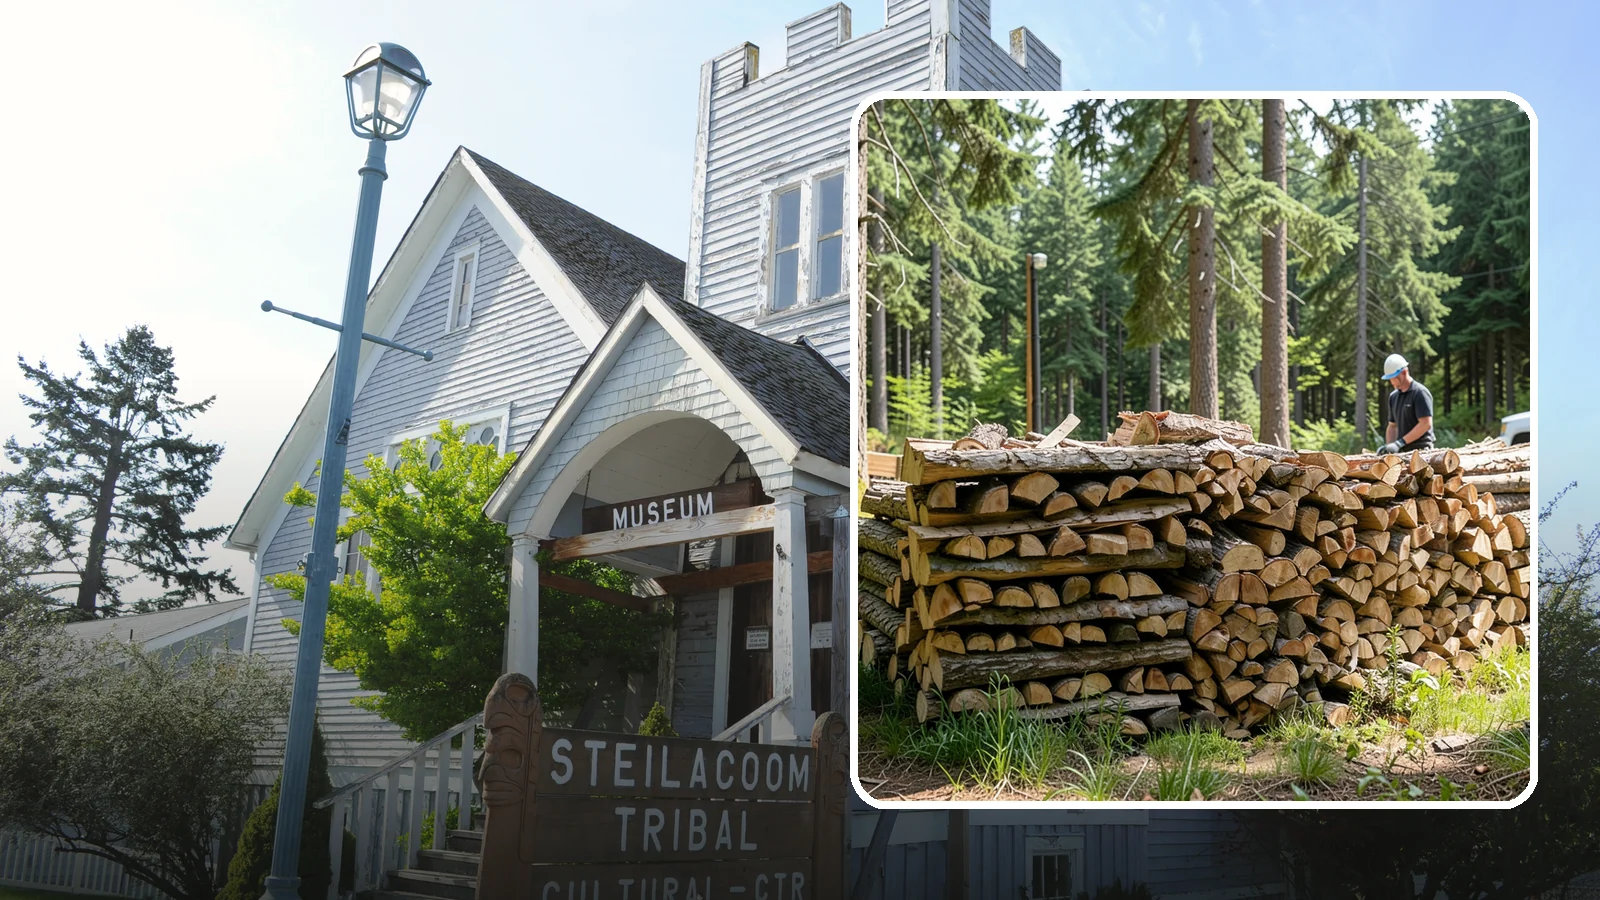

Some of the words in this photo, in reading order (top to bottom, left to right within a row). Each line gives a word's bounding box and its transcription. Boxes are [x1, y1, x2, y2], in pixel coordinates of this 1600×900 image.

[613, 491, 714, 531] MUSEUM
[550, 738, 810, 792] STEILACOOM
[615, 806, 758, 852] TRIBAL
